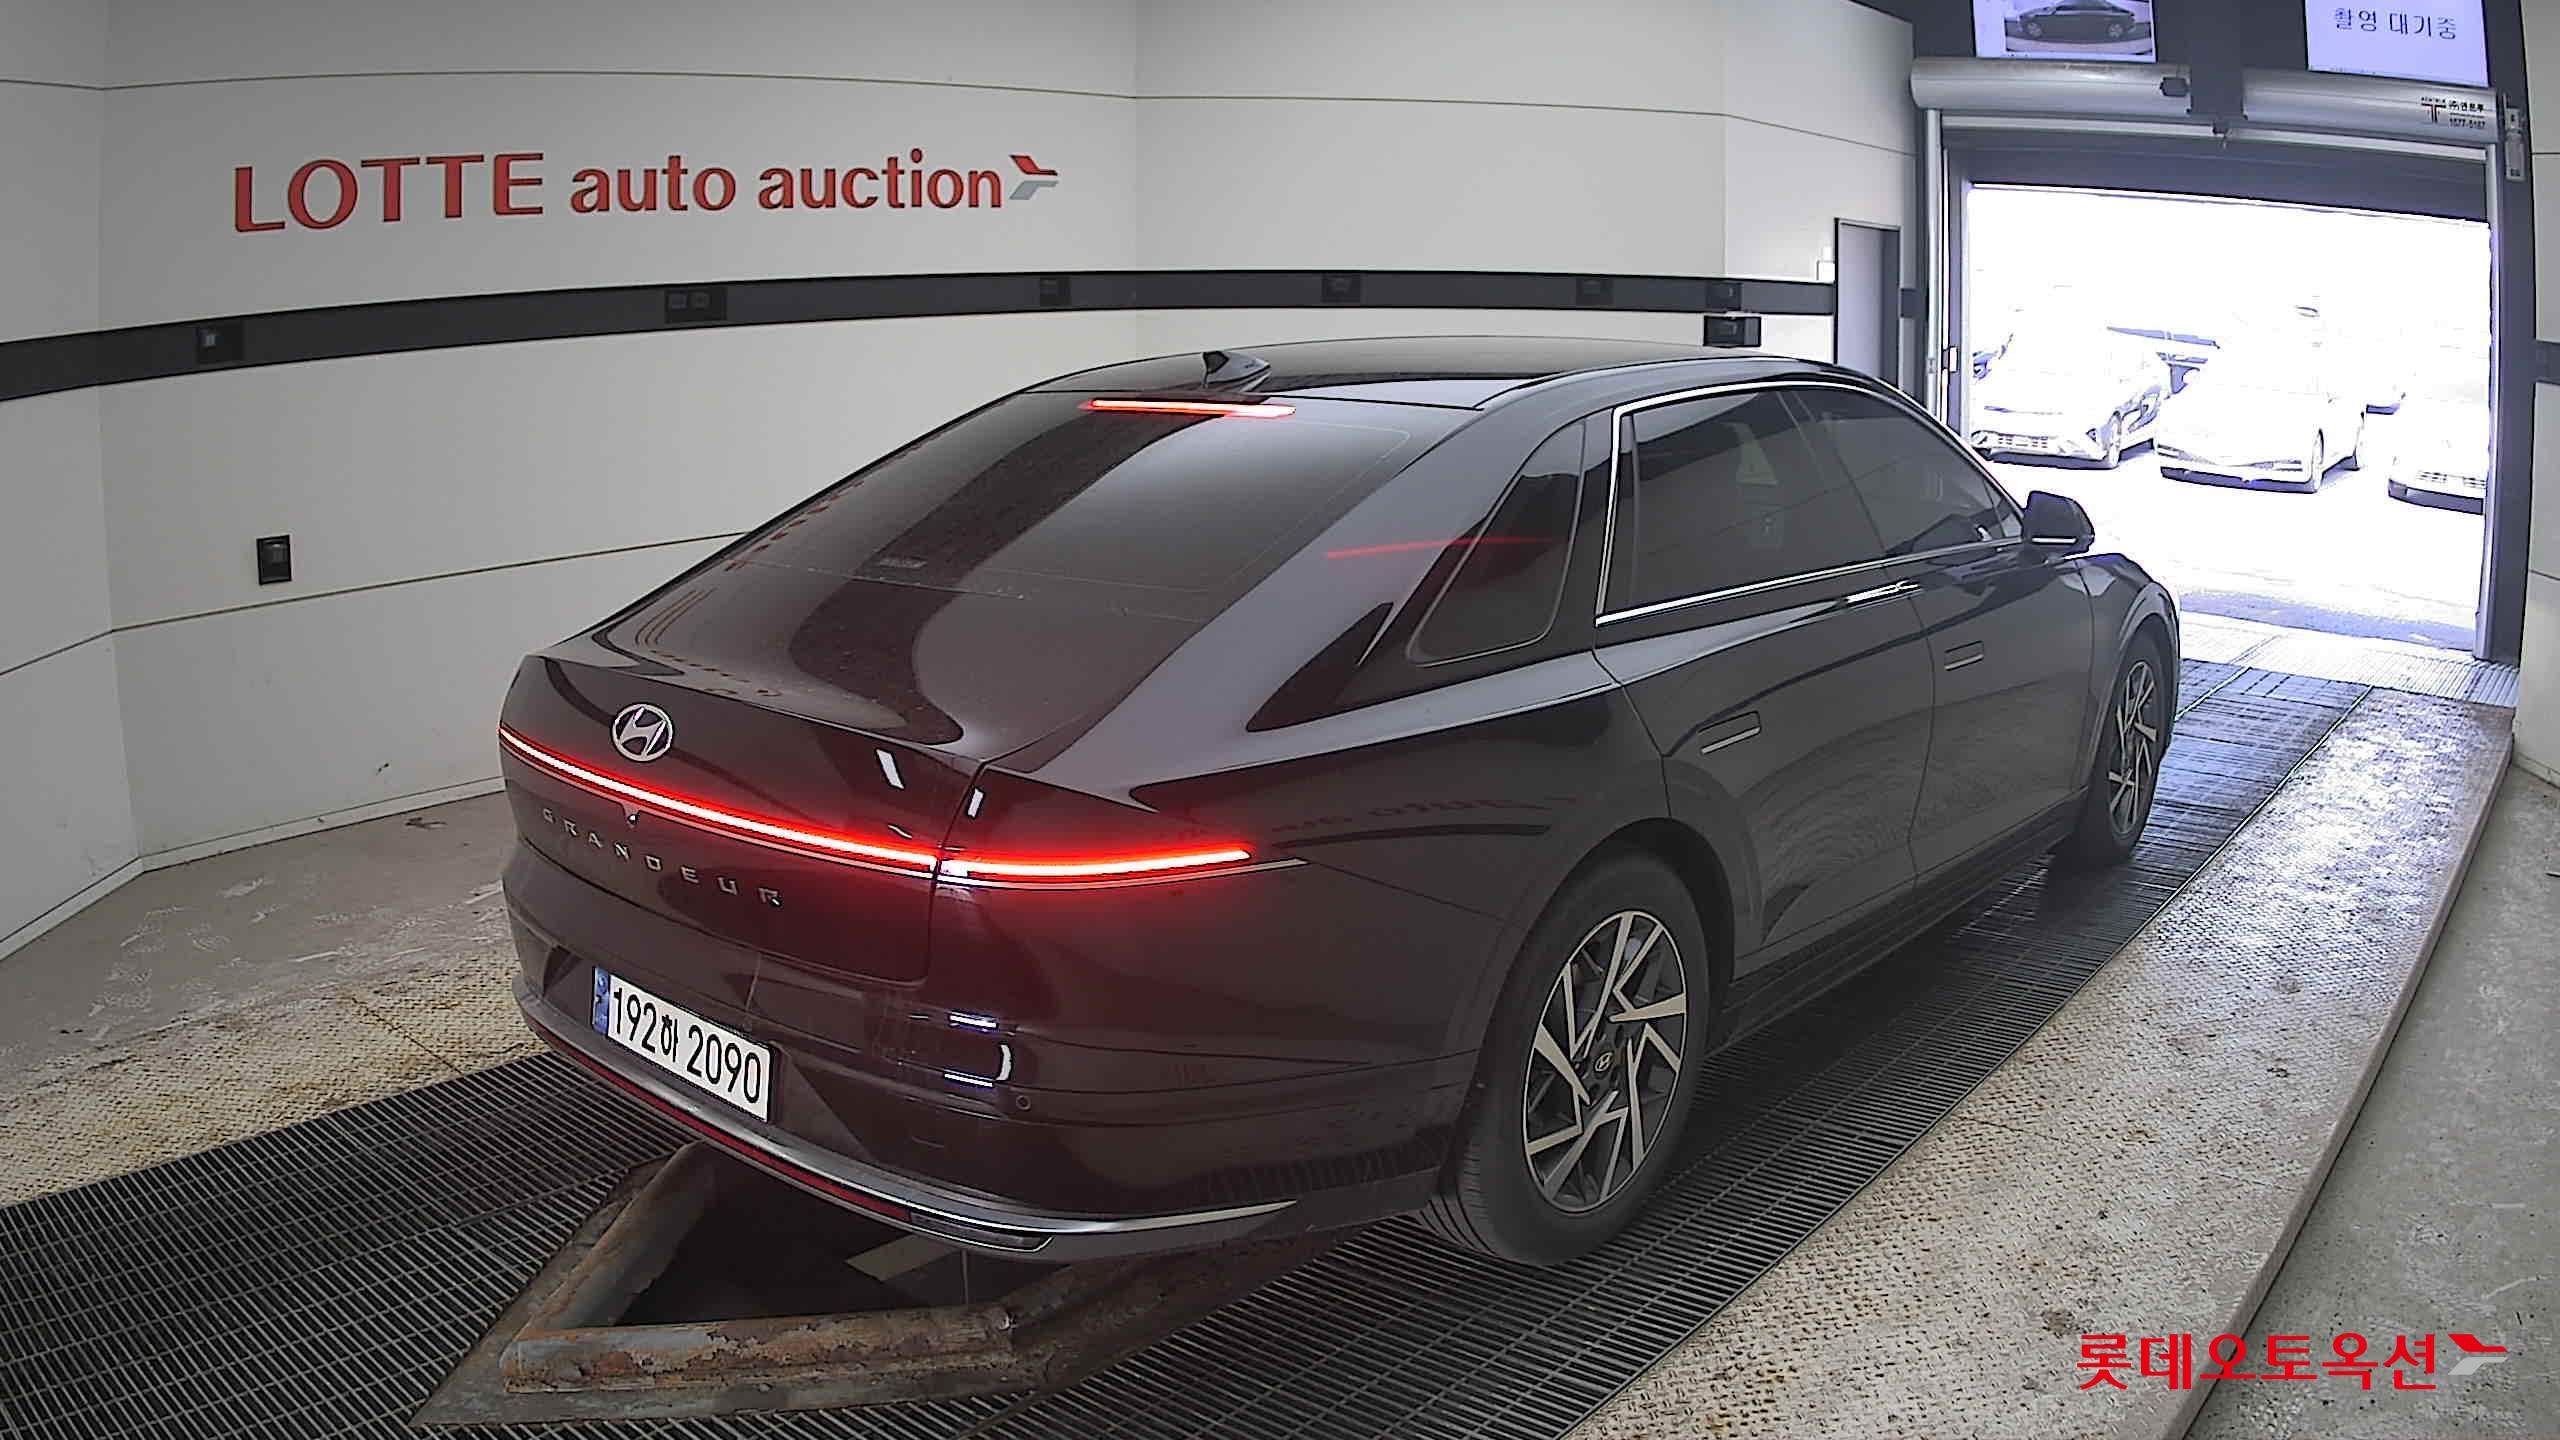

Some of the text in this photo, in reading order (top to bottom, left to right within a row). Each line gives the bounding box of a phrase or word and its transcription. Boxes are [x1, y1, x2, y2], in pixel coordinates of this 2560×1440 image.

[2335, 7, 2457, 40] 촬영 대기중
[234, 147, 1003, 233] LOTTE auto auction
[541, 808, 784, 908] GRANDEUR
[612, 986, 761, 1105] 192하 2090
